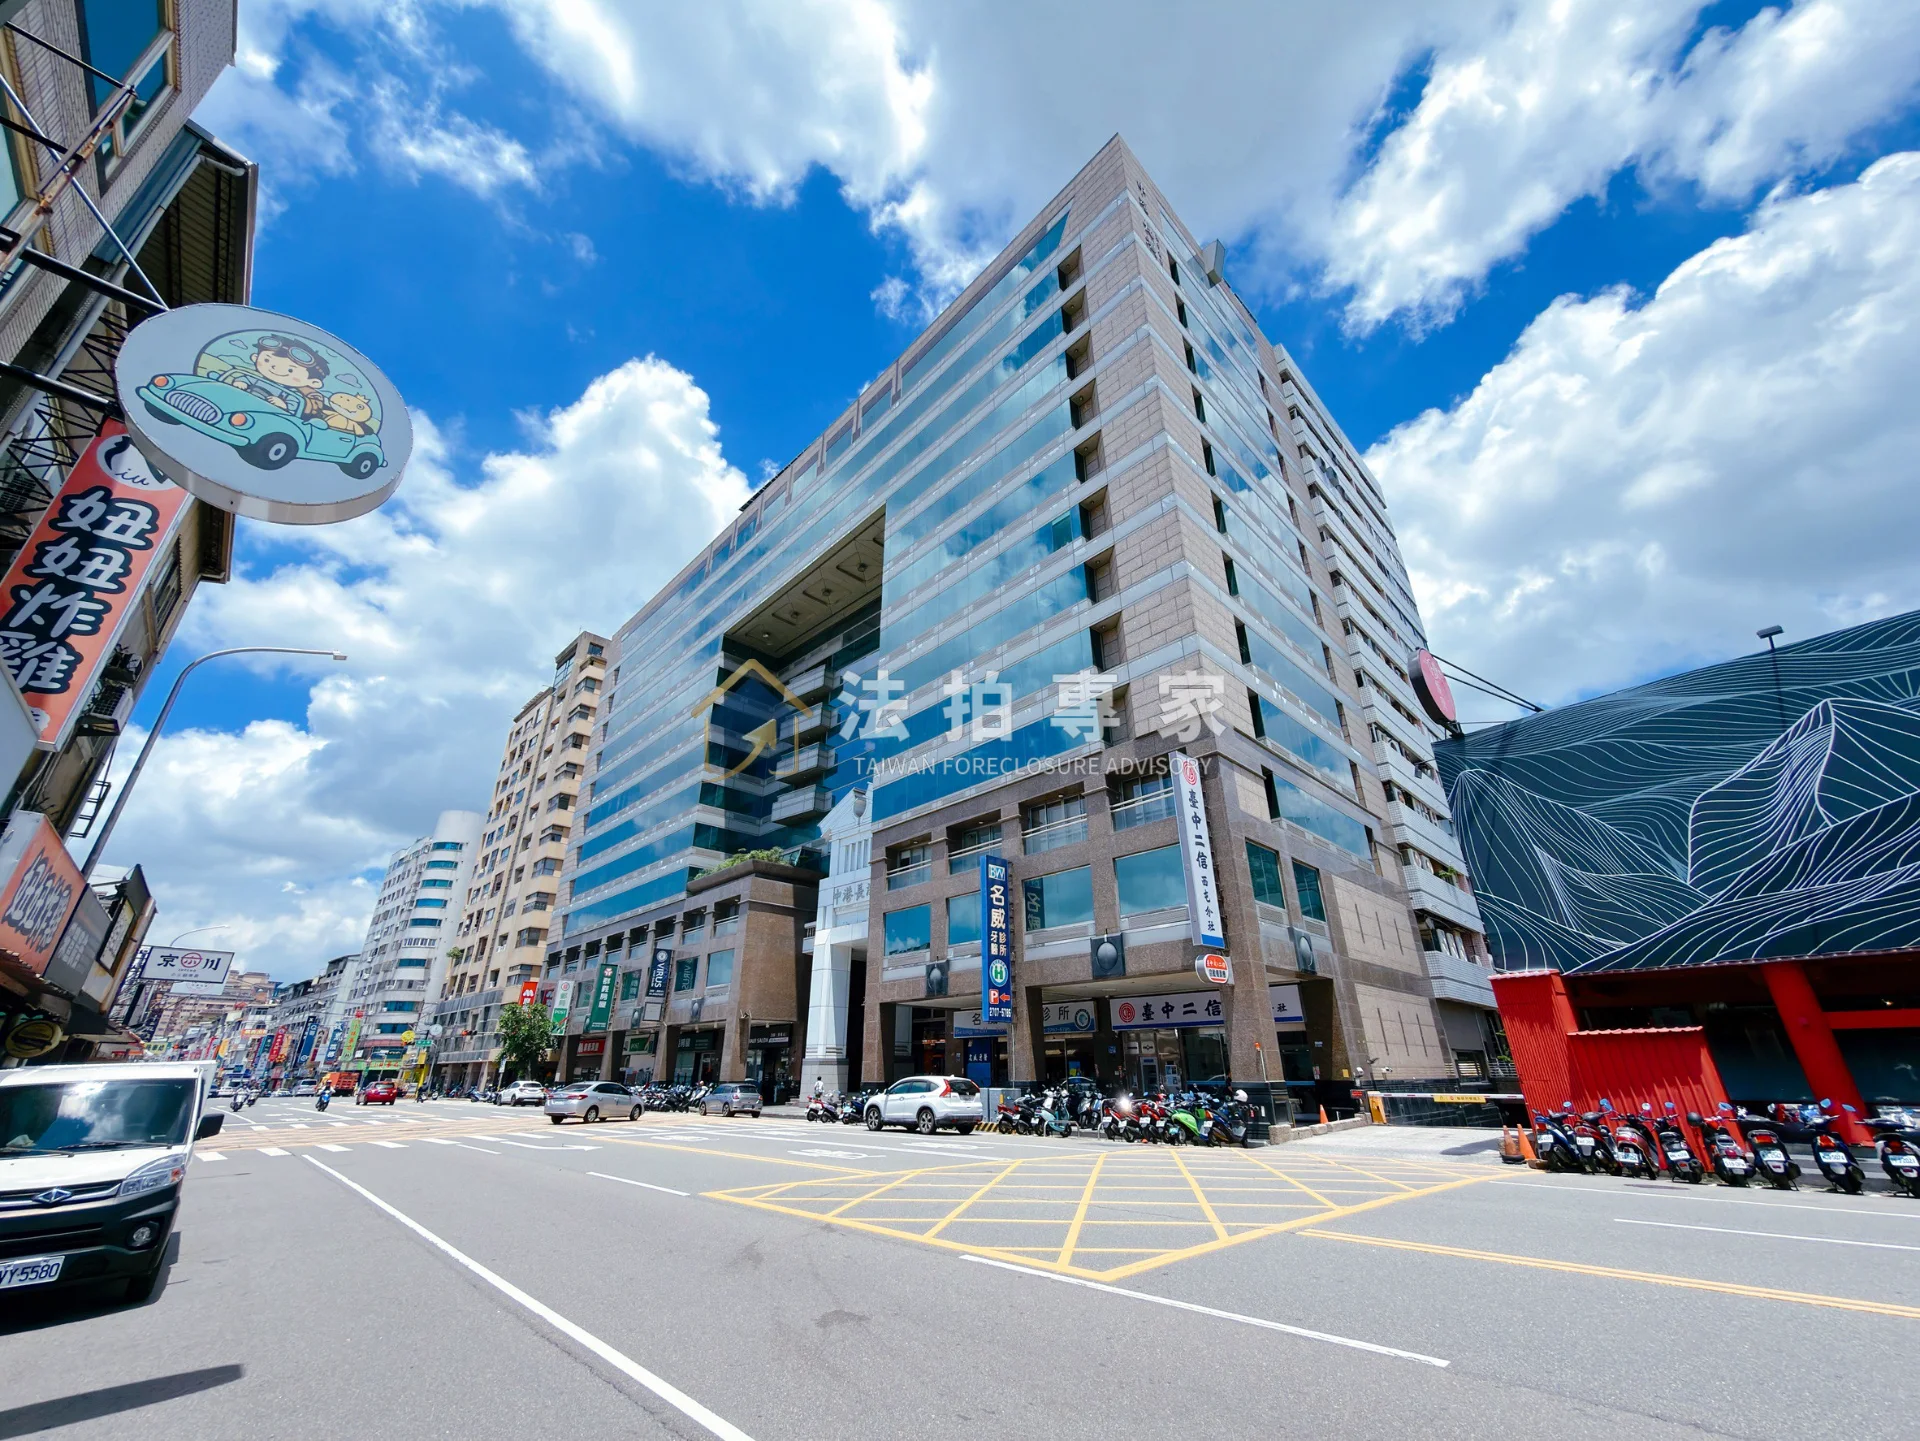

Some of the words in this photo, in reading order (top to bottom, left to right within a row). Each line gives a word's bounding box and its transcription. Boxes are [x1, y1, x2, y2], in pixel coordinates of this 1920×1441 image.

[990, 885, 1006, 930] 名威
[655, 963, 665, 988] VIRUS
[990, 991, 998, 1003] P
[1142, 1000, 1222, 1021] 臺中二信
